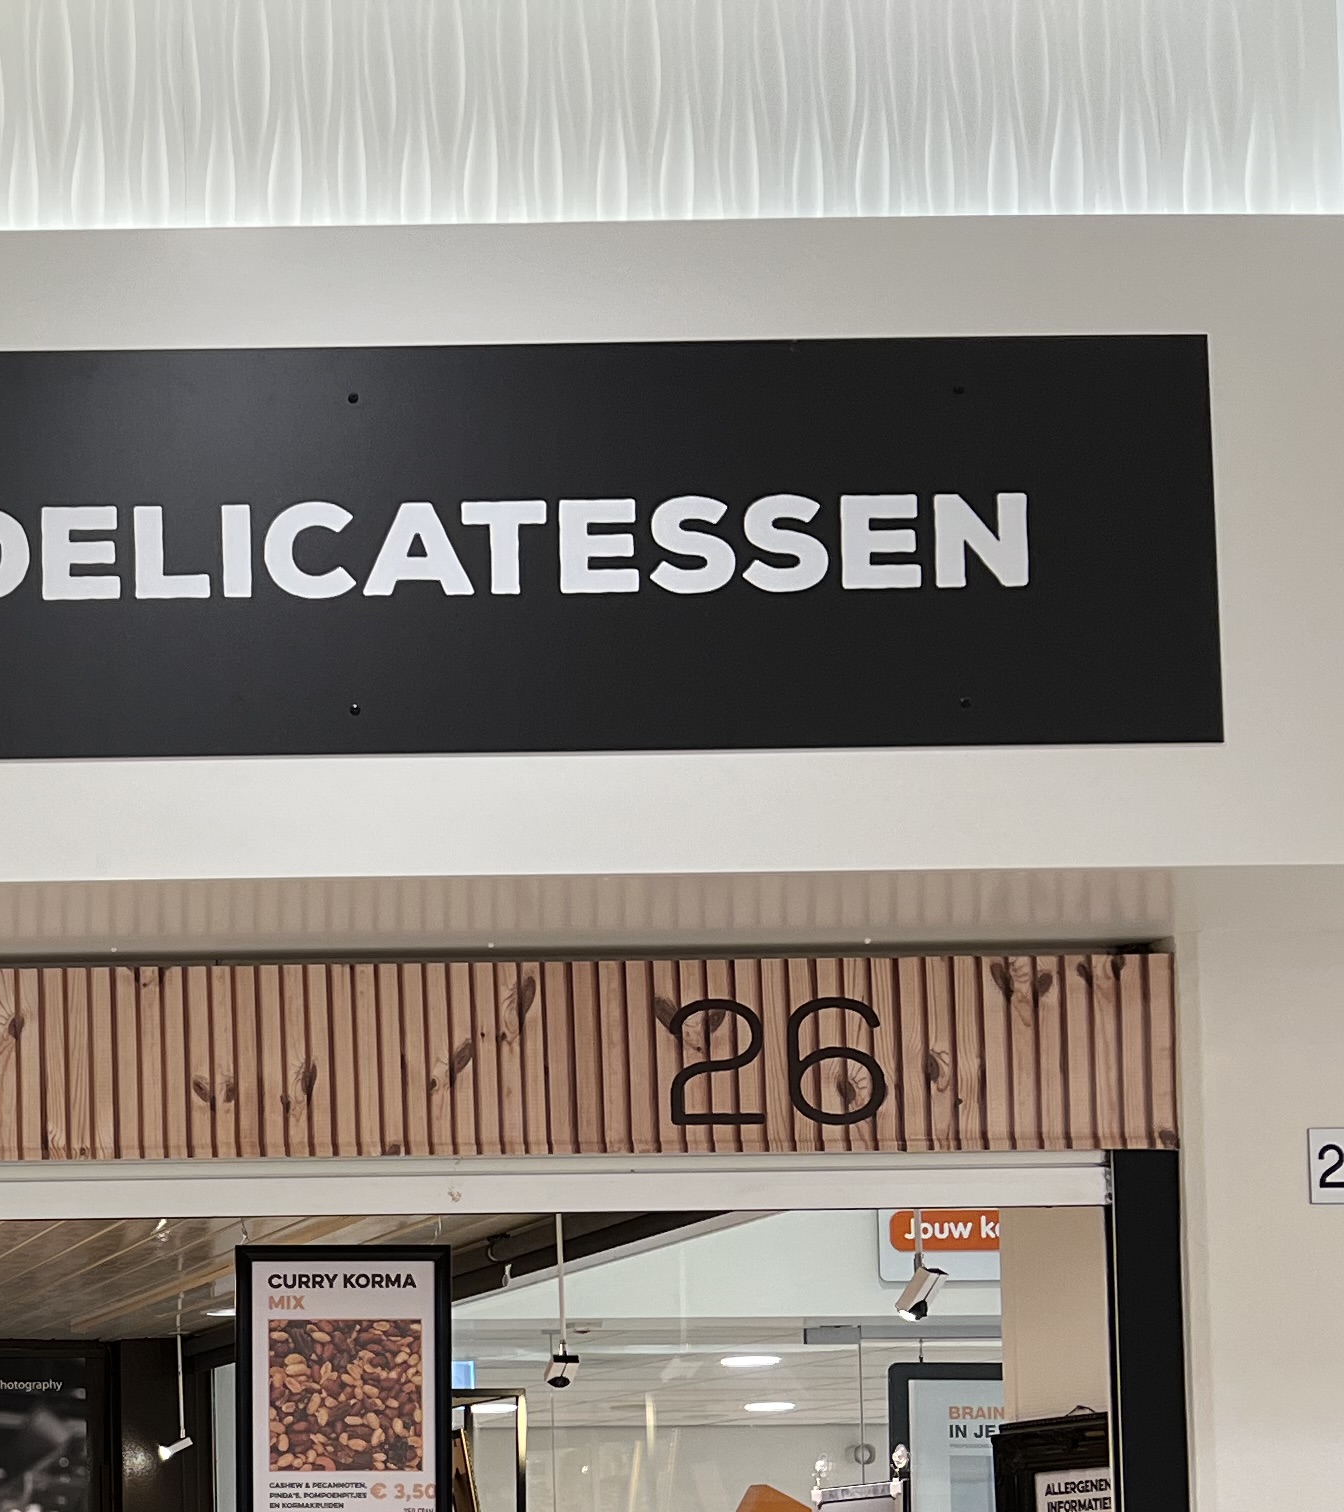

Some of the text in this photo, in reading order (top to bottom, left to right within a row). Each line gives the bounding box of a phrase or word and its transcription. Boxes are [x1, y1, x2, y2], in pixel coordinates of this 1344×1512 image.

[669, 996, 887, 1126] 26
[903, 1217, 973, 1239] Jouw
[268, 1273, 417, 1289] CURRY KORMA
[268, 1295, 306, 1310] MIX
[948, 1406, 1004, 1420] BRAIN
[948, 1425, 968, 1439] IN
[370, 1482, 435, 1502] € 3,50
[1045, 1478, 1111, 1496] ALLERGENEN
